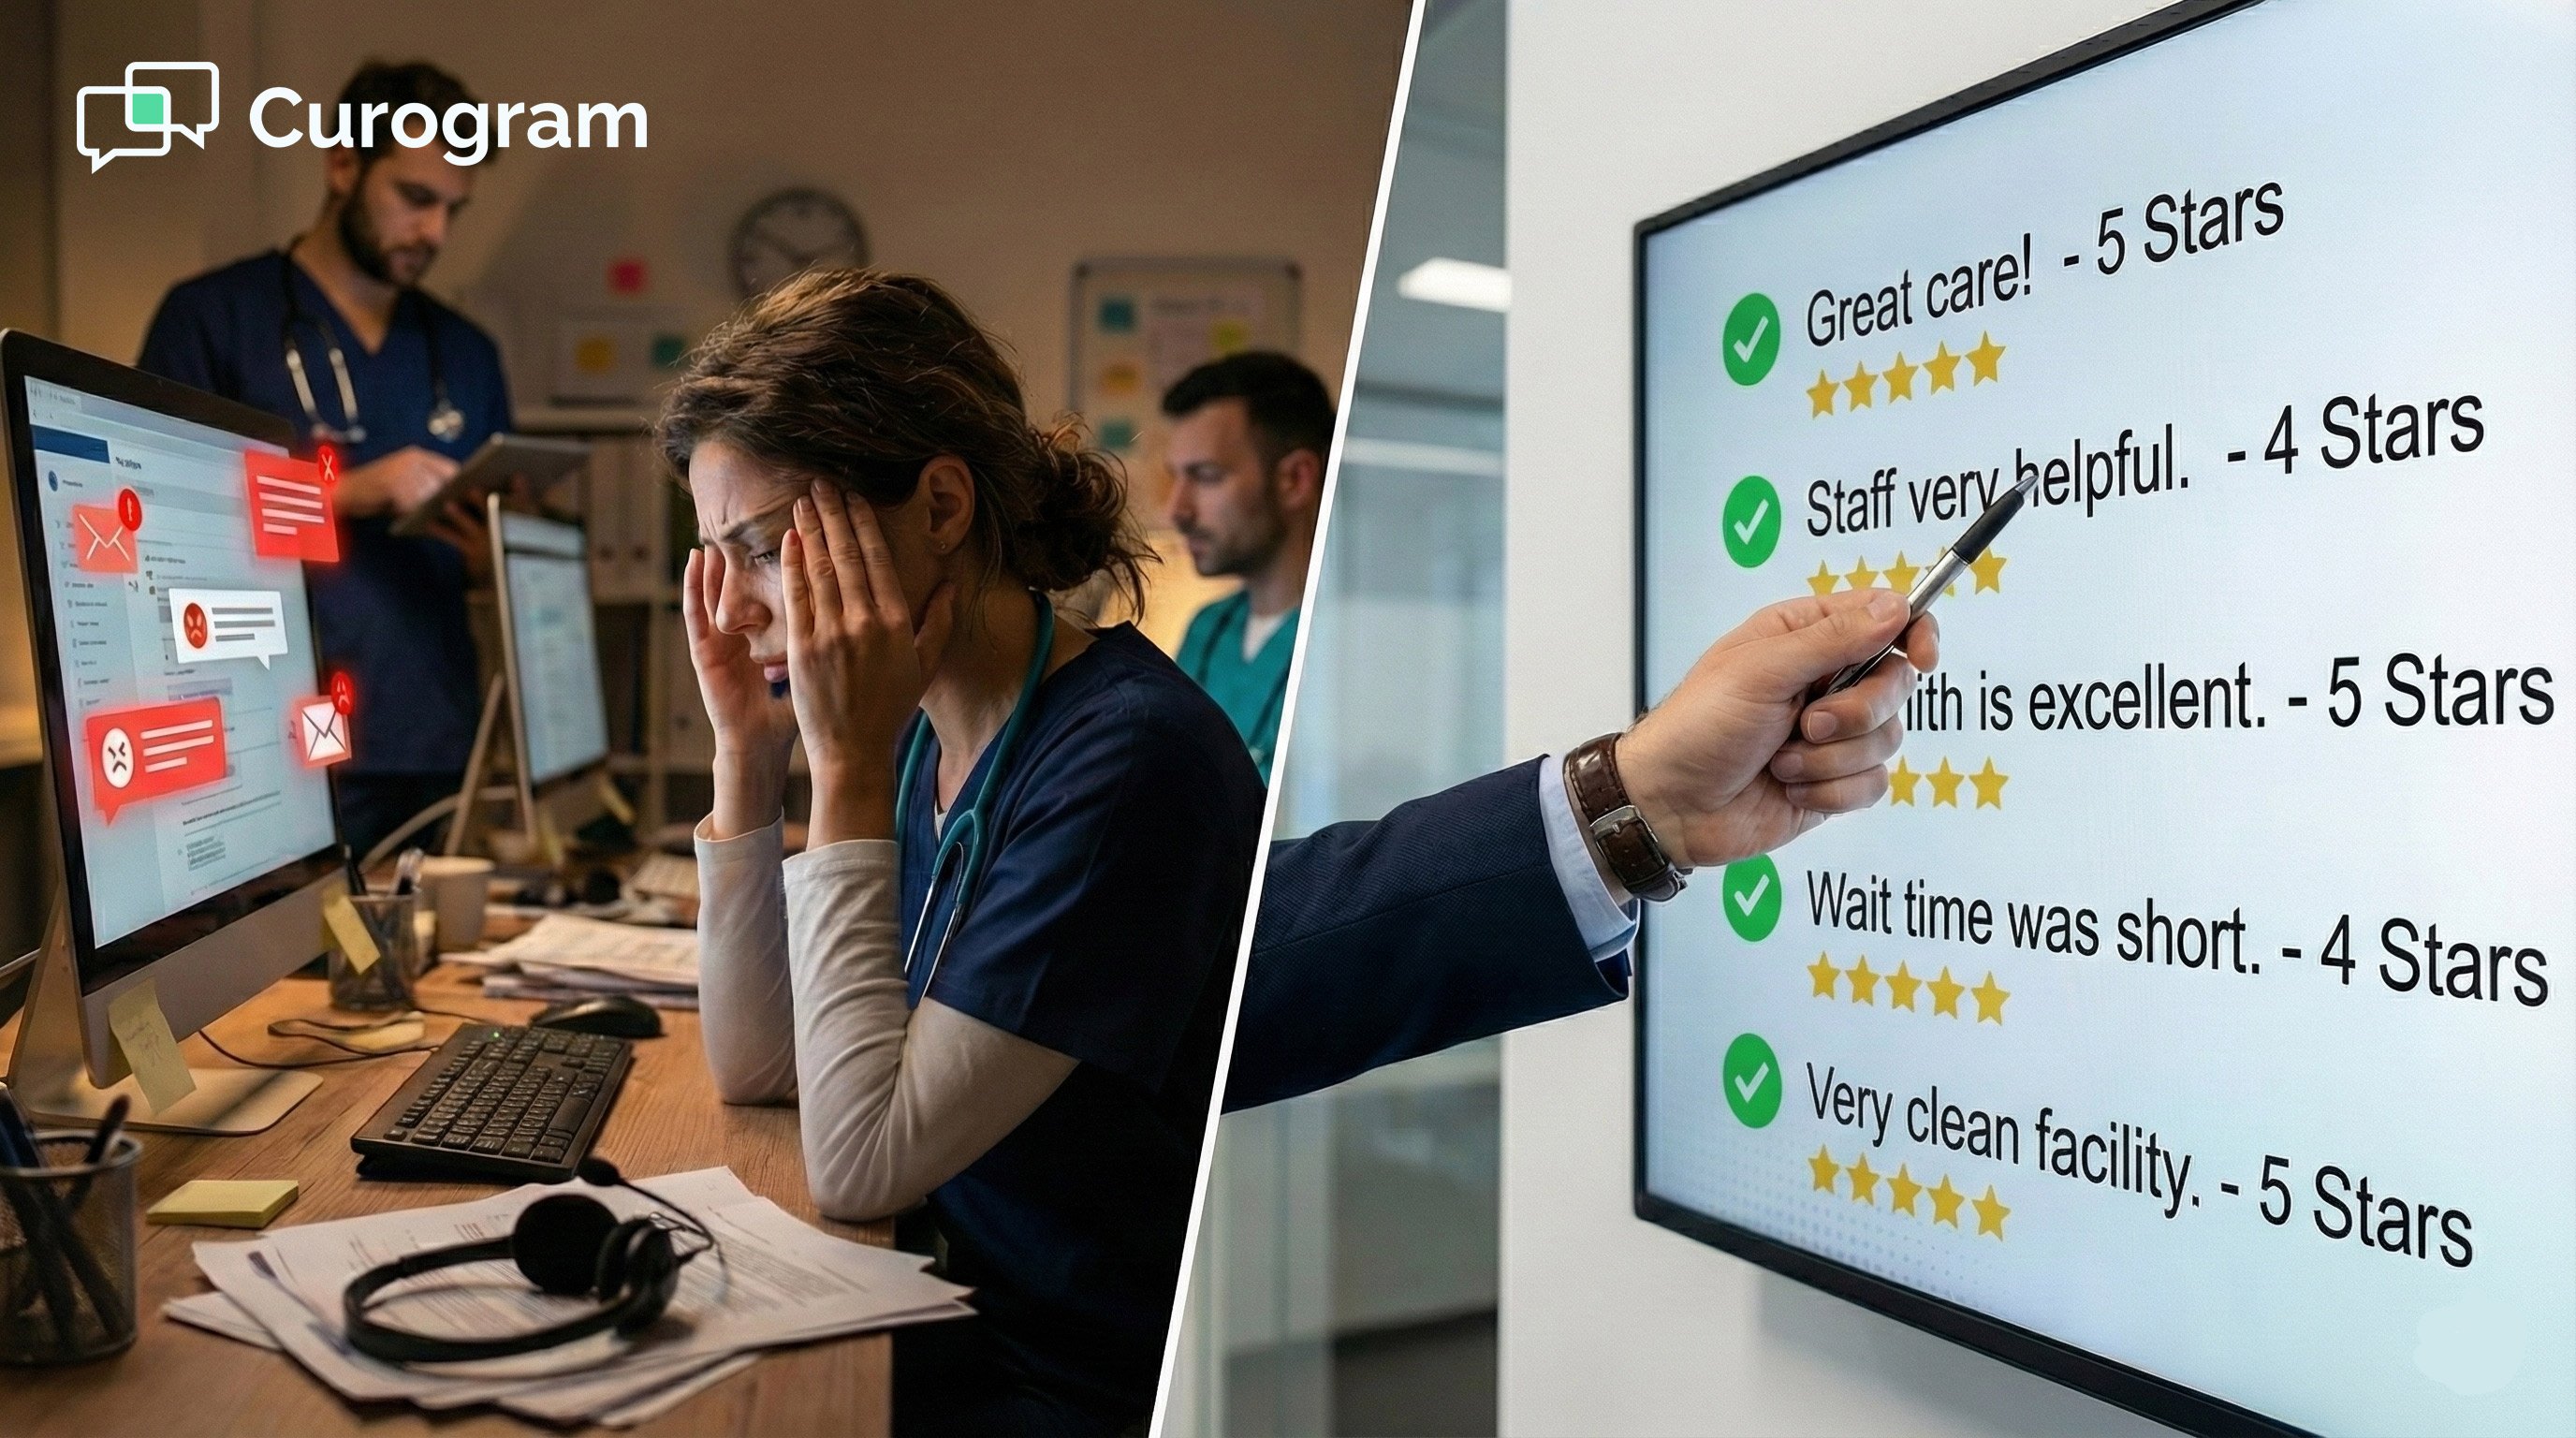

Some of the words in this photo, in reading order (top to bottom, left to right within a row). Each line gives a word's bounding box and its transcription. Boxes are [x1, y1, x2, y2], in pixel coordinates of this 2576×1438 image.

[1807, 270, 1913, 347] Great
[1926, 233, 2032, 318] care!
[2063, 255, 2080, 267] -
[2097, 207, 2126, 275] 5
[2144, 182, 2284, 263] Stars
[1807, 467, 1897, 537] Staff
[1908, 468, 1999, 523] very
[2015, 424, 2189, 518] helpful.
[2227, 450, 2247, 462] -
[2264, 404, 2299, 475] 4
[2320, 392, 2484, 469] Stars
[1980, 669, 2013, 731] is
[2029, 661, 2265, 731] excellent.
[2288, 697, 2307, 707] -
[2328, 656, 2362, 727] 5
[2384, 653, 2554, 727] Stars
[1807, 870, 1893, 935] Wait
[1904, 879, 1993, 945] time
[2007, 902, 2100, 957] was
[2116, 897, 2260, 975] short.
[2282, 947, 2302, 959] -
[2320, 914, 2356, 986] 4
[2379, 917, 2549, 1007] Stars
[1806, 1062, 1894, 1148] Very
[1906, 1085, 2019, 1165] clean
[2034, 1107, 2200, 1219] facility.
[2220, 1182, 2239, 1196] -
[2260, 1154, 2291, 1225] 5
[2313, 1165, 2473, 1269] Stars
